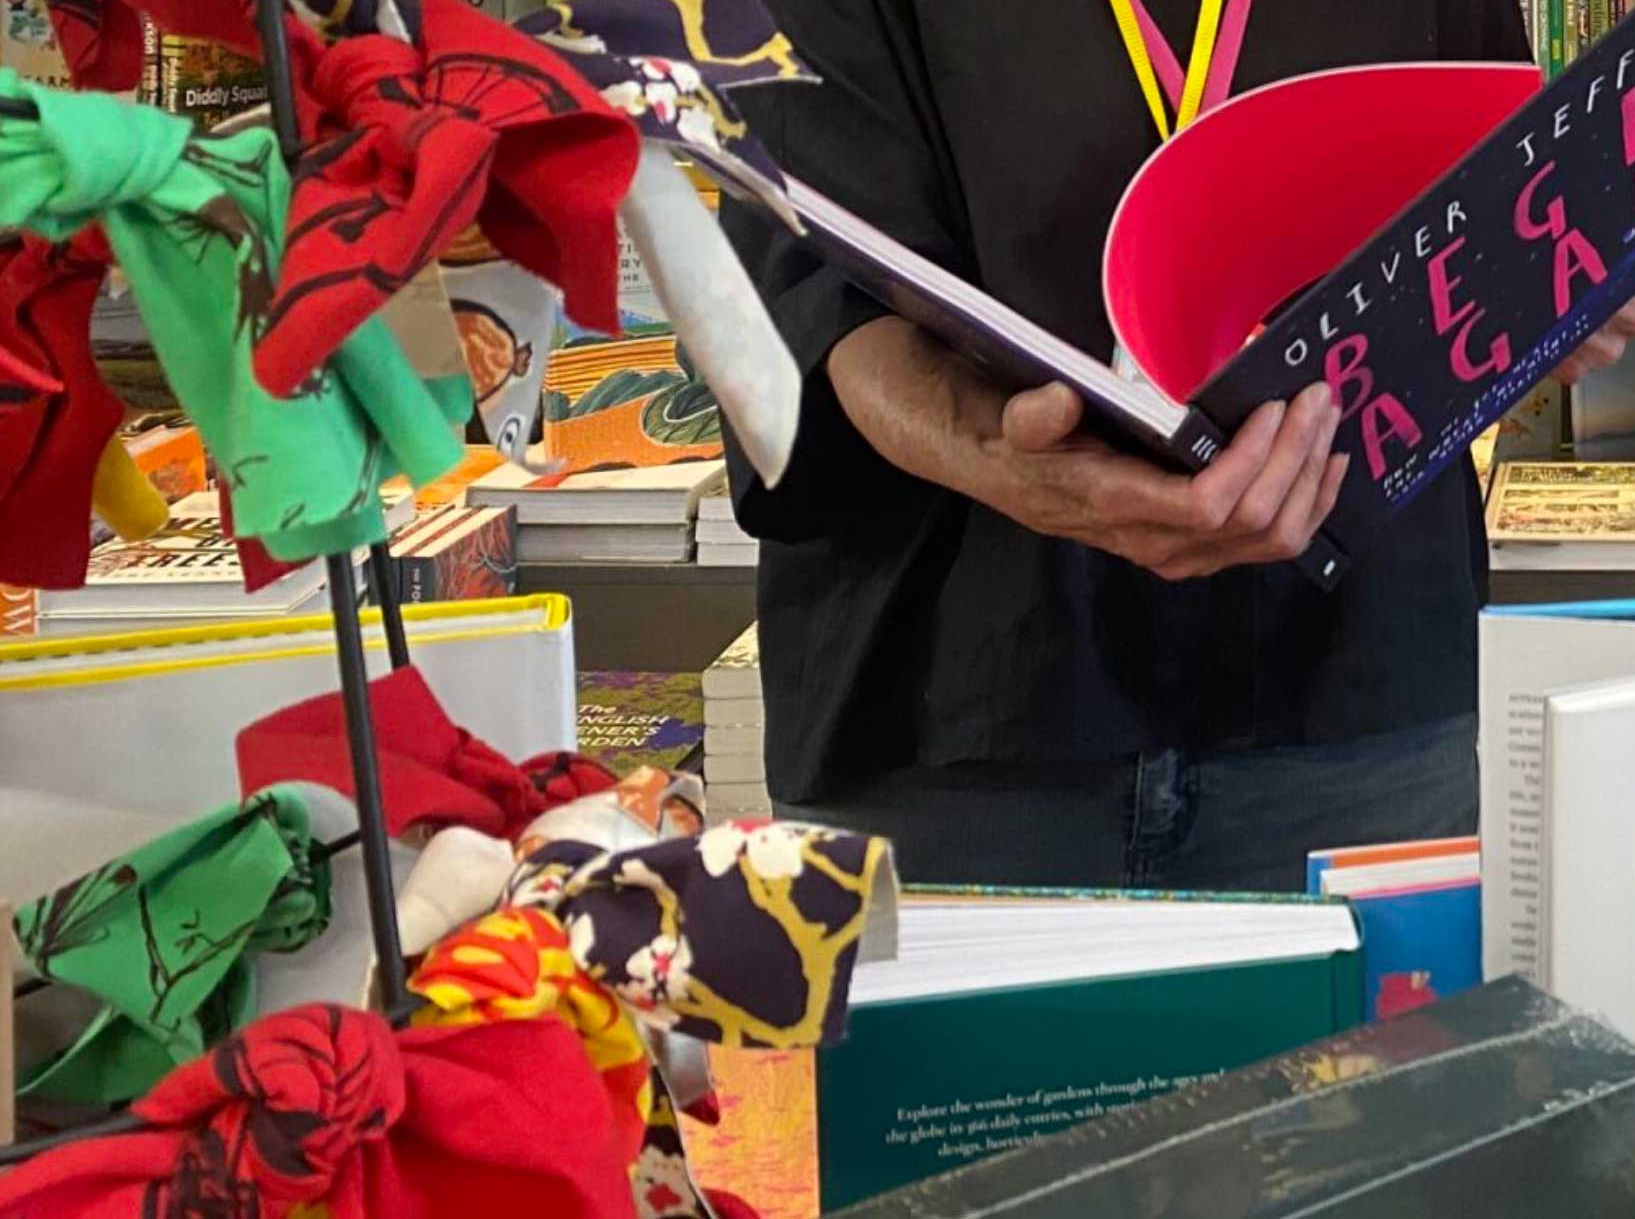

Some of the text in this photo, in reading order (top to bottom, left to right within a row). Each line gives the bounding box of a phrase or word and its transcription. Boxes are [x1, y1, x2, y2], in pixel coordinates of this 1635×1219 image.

[186, 87, 229, 107] Diddly
[1284, 199, 1467, 367] OLIVER
[579, 705, 616, 713] The
[579, 716, 671, 724] NGLISH
[896, 1077, 1146, 1122] Explore the wonder gardens through
[909, 1112, 1021, 1143] globe daily
[937, 1139, 983, 1157] design,
